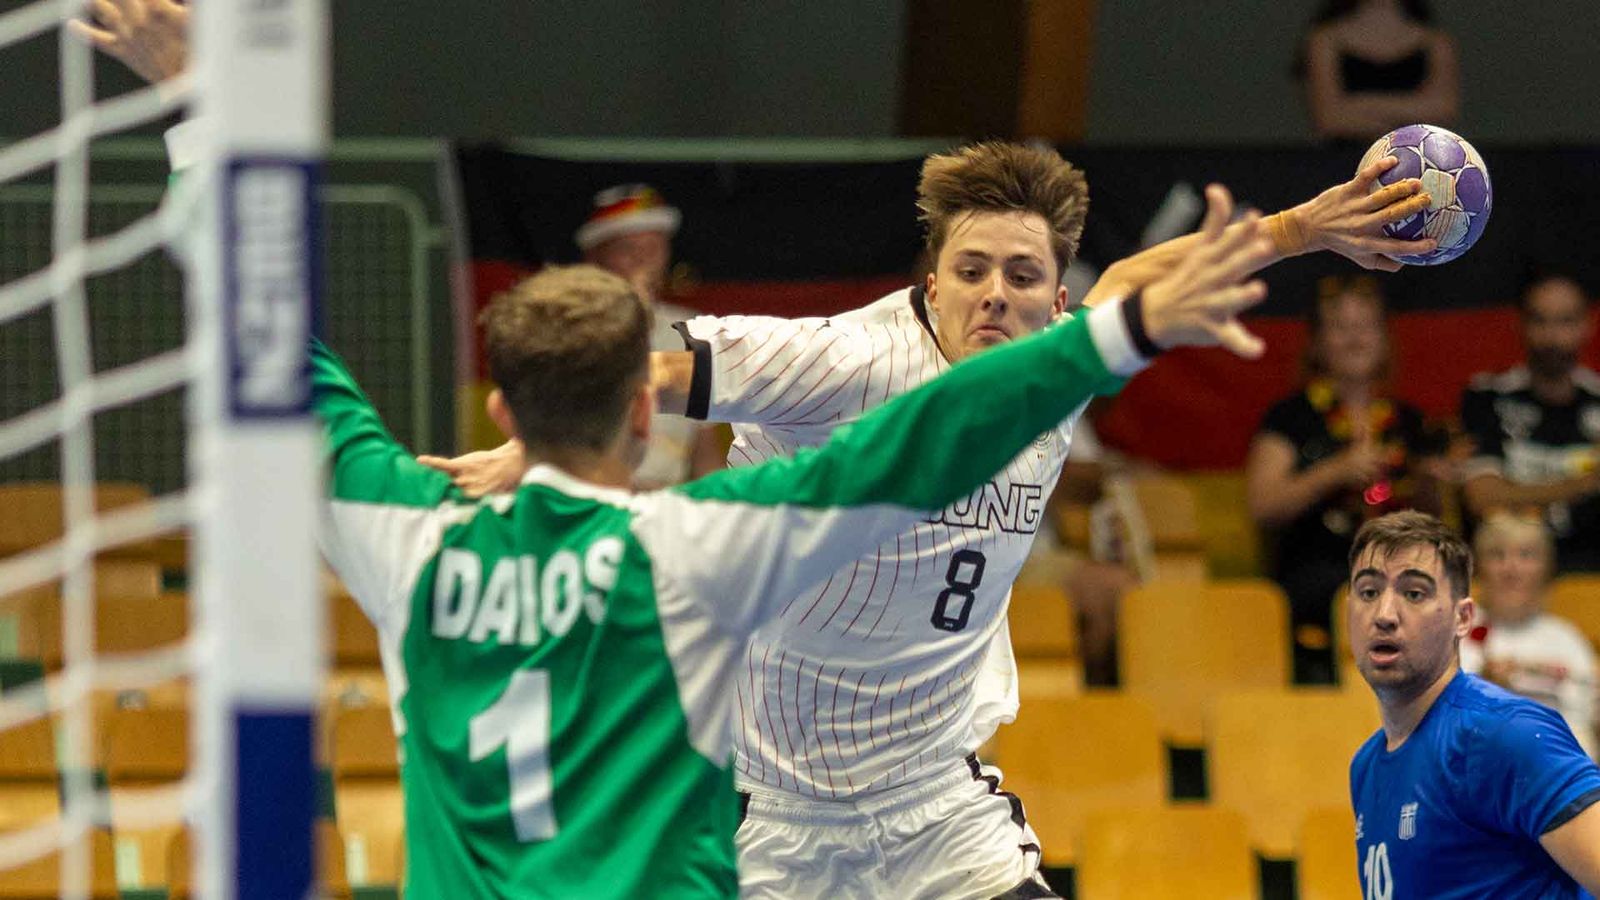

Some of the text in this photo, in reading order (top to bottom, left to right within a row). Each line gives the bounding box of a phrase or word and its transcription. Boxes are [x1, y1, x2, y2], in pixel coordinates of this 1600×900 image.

[921, 481, 1041, 534] UNG
[431, 537, 625, 646] DAIOS
[930, 549, 987, 632] 8
[469, 667, 559, 843] 1
